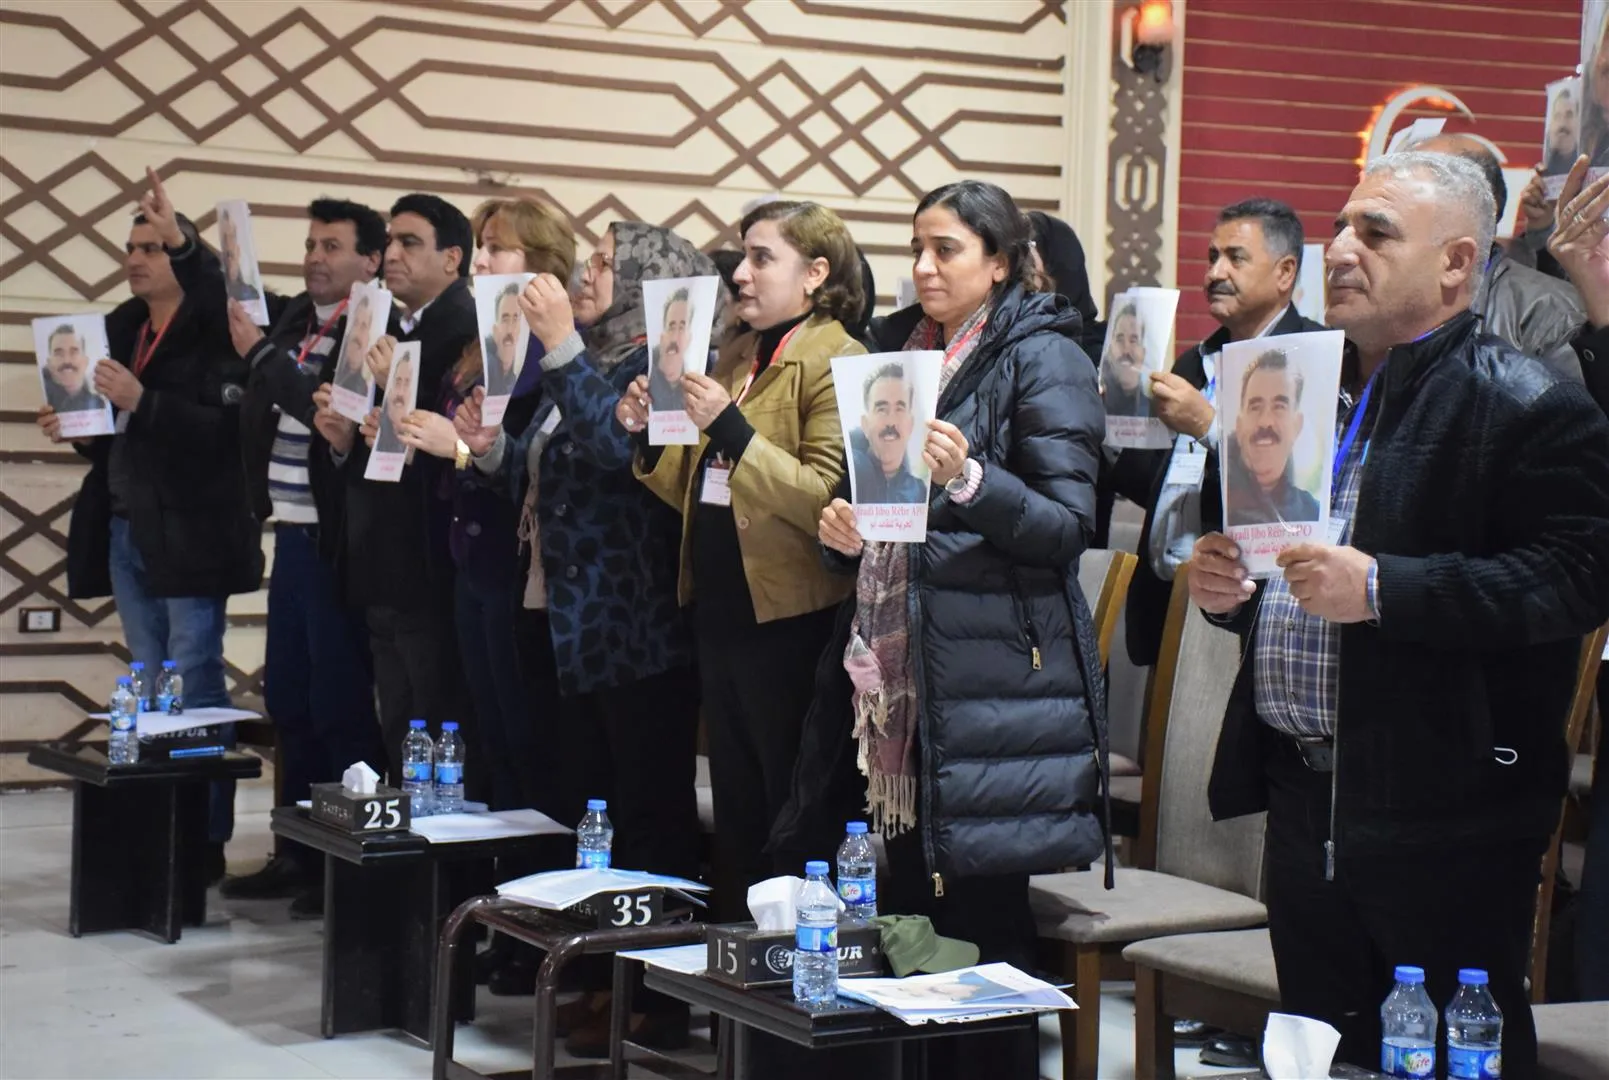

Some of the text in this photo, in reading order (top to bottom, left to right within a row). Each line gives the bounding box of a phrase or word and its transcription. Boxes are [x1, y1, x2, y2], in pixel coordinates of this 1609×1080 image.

[363, 799, 401, 829] 25
[611, 894, 652, 927] 35
[716, 939, 738, 975] 15
